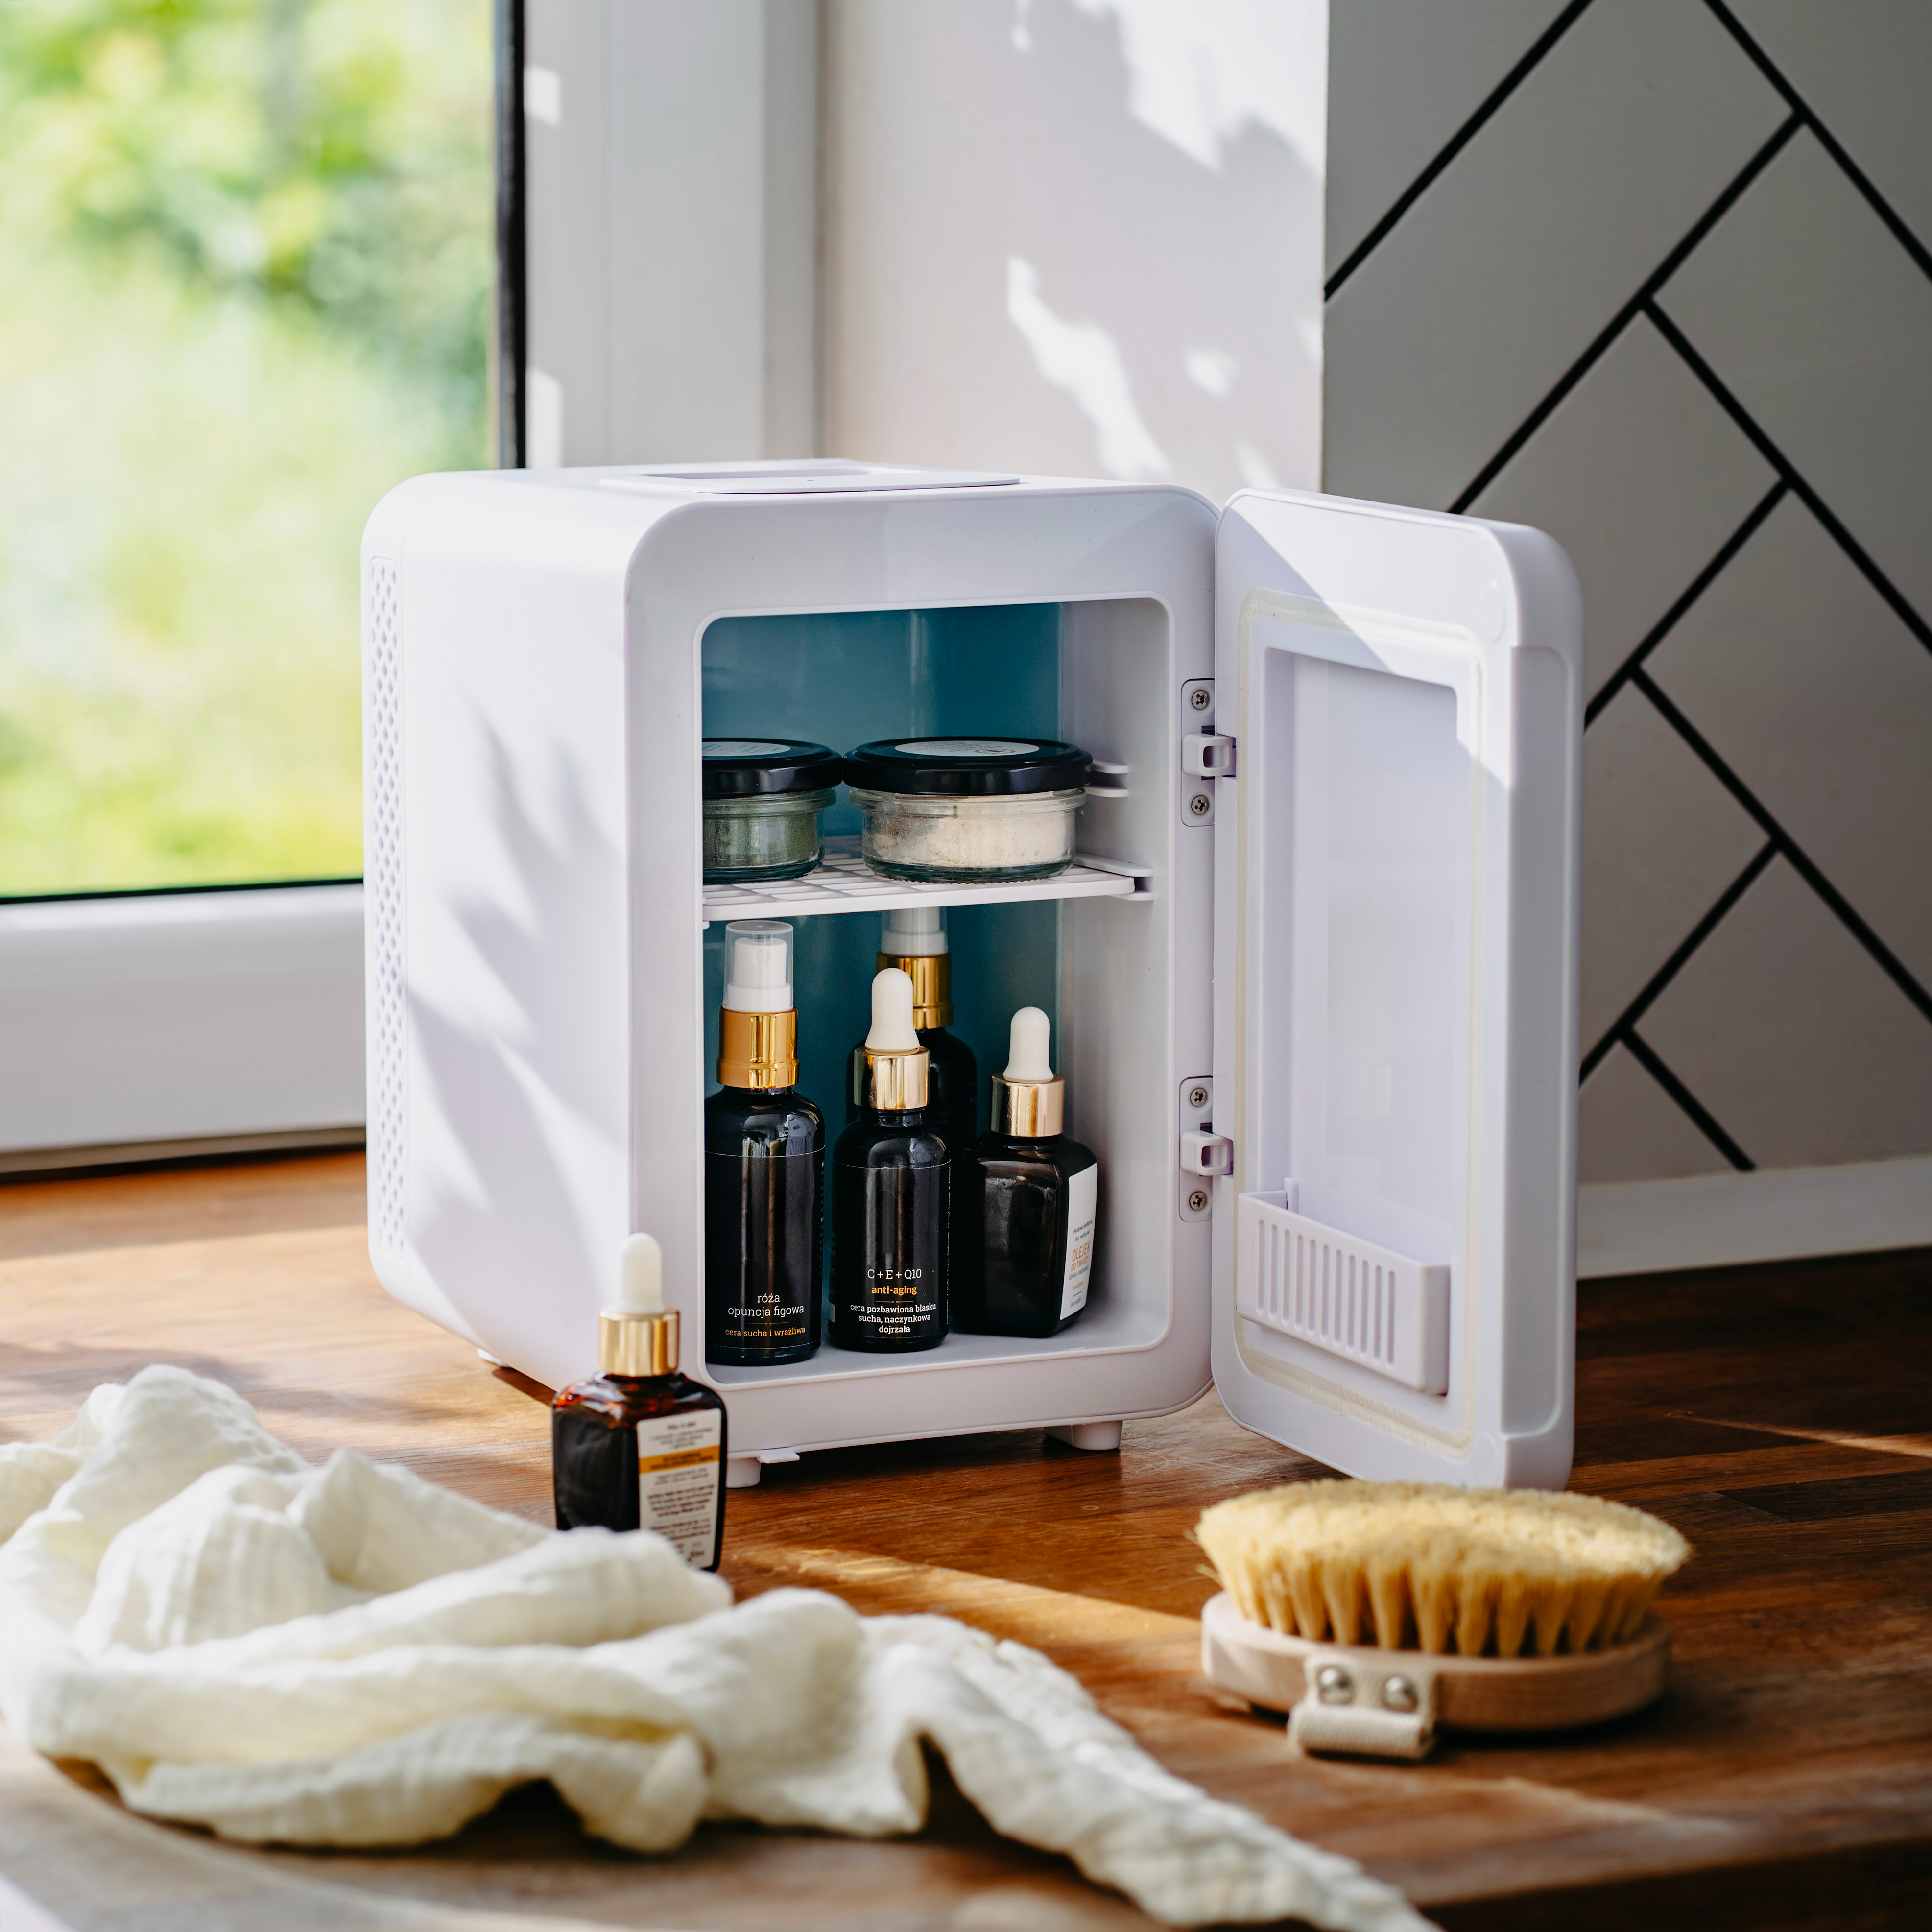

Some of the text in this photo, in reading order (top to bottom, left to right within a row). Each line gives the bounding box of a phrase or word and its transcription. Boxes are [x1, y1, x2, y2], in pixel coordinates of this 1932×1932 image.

[1072, 1240, 1090, 1262] OLEJEK
[867, 1269, 875, 1279] C
[885, 1270, 893, 1280] E
[904, 1268, 922, 1280] Q10
[871, 1285, 917, 1296] anti-aging
[757, 1293, 780, 1303] róża
[728, 1305, 804, 1318] opuncja figowa
[867, 1305, 914, 1313] pozbawiona
[915, 1303, 936, 1312] blasku
[858, 1314, 931, 1324] sucha, naczynkowa
[774, 1327, 805, 1336] wrażliwa
[879, 1325, 910, 1335] dojrzała
